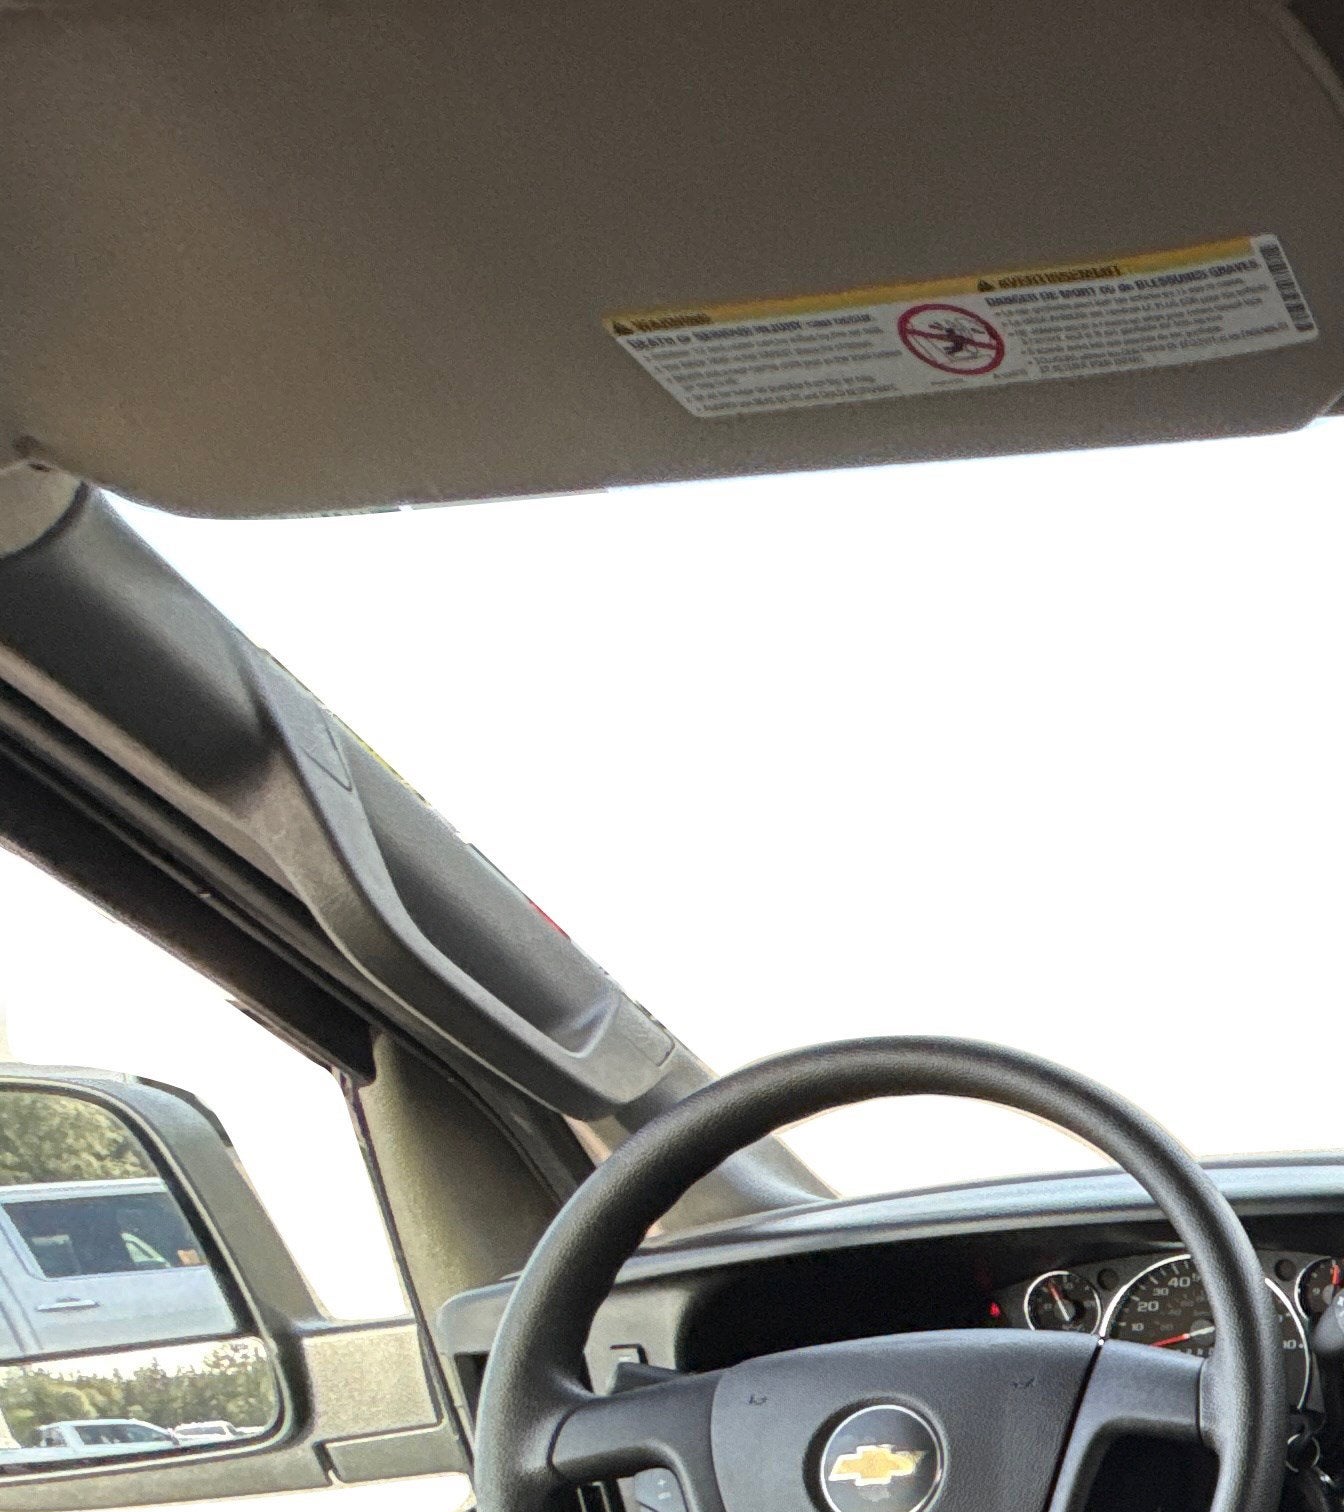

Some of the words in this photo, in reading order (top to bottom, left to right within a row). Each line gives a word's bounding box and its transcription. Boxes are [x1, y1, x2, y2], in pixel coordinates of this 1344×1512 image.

[1168, 1276, 1190, 1288] 40
[1153, 1287, 1169, 1297] 30
[1137, 1301, 1159, 1313] 20
[1131, 1322, 1145, 1332] 10
